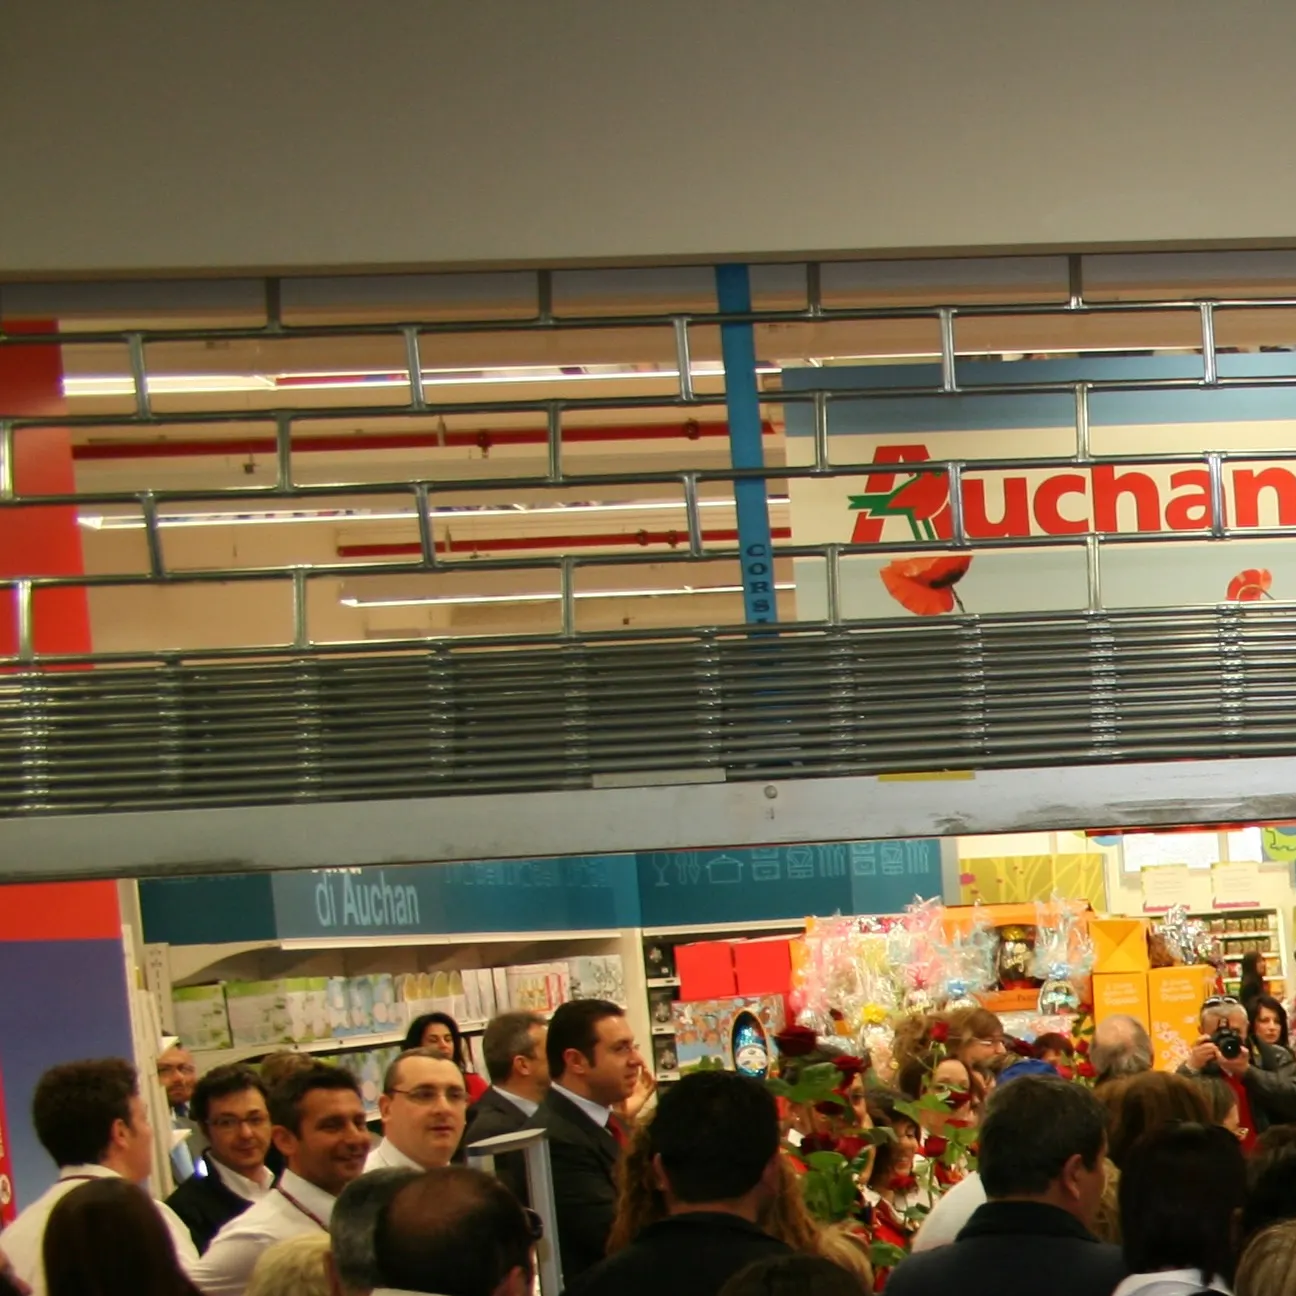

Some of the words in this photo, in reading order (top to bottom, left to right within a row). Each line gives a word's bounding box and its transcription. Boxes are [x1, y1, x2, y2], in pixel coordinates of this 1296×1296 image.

[746, 544, 770, 623] CORS
[315, 873, 337, 927] di
[343, 870, 420, 926] Auchan
